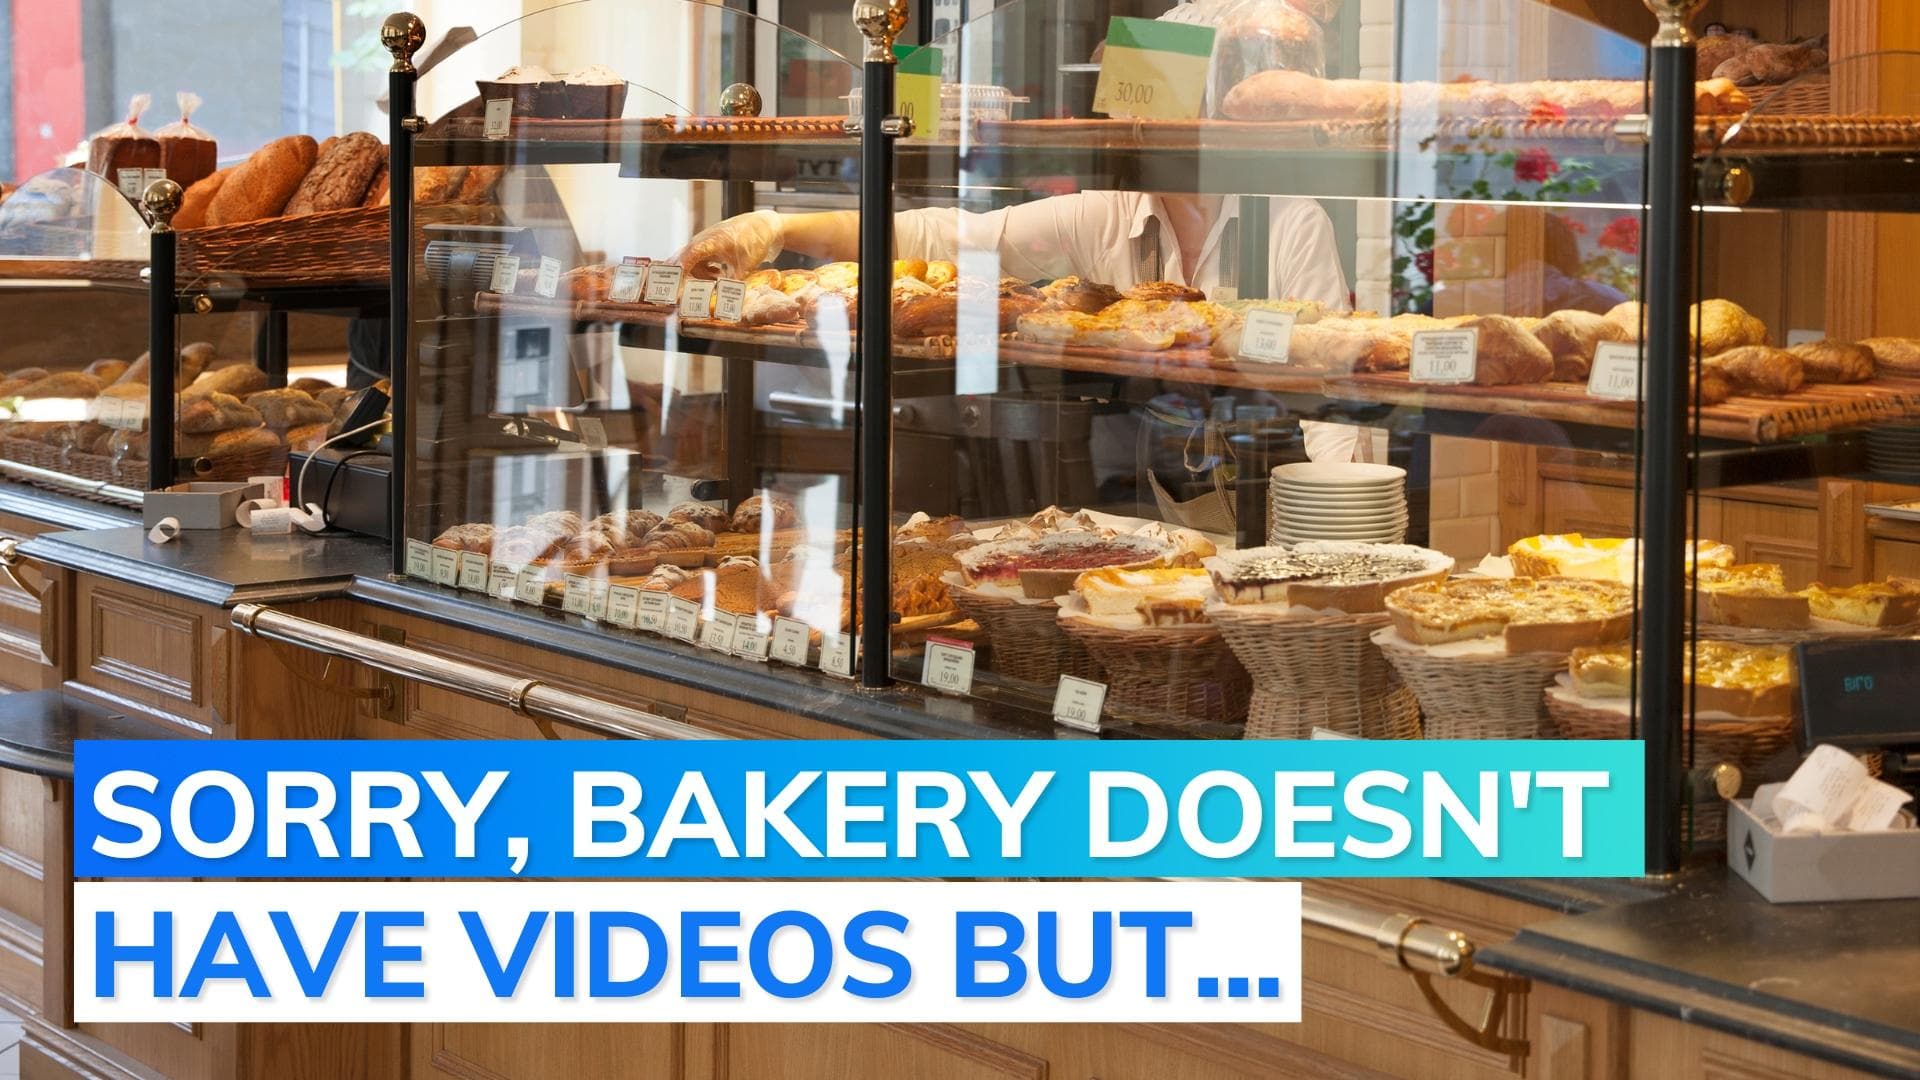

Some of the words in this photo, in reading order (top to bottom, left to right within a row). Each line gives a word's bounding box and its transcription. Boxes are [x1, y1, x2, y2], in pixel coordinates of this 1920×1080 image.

[1114, 81, 1154, 105] 30,00
[1429, 359, 1457, 376] 11,00
[940, 671, 960, 685] 19,00
